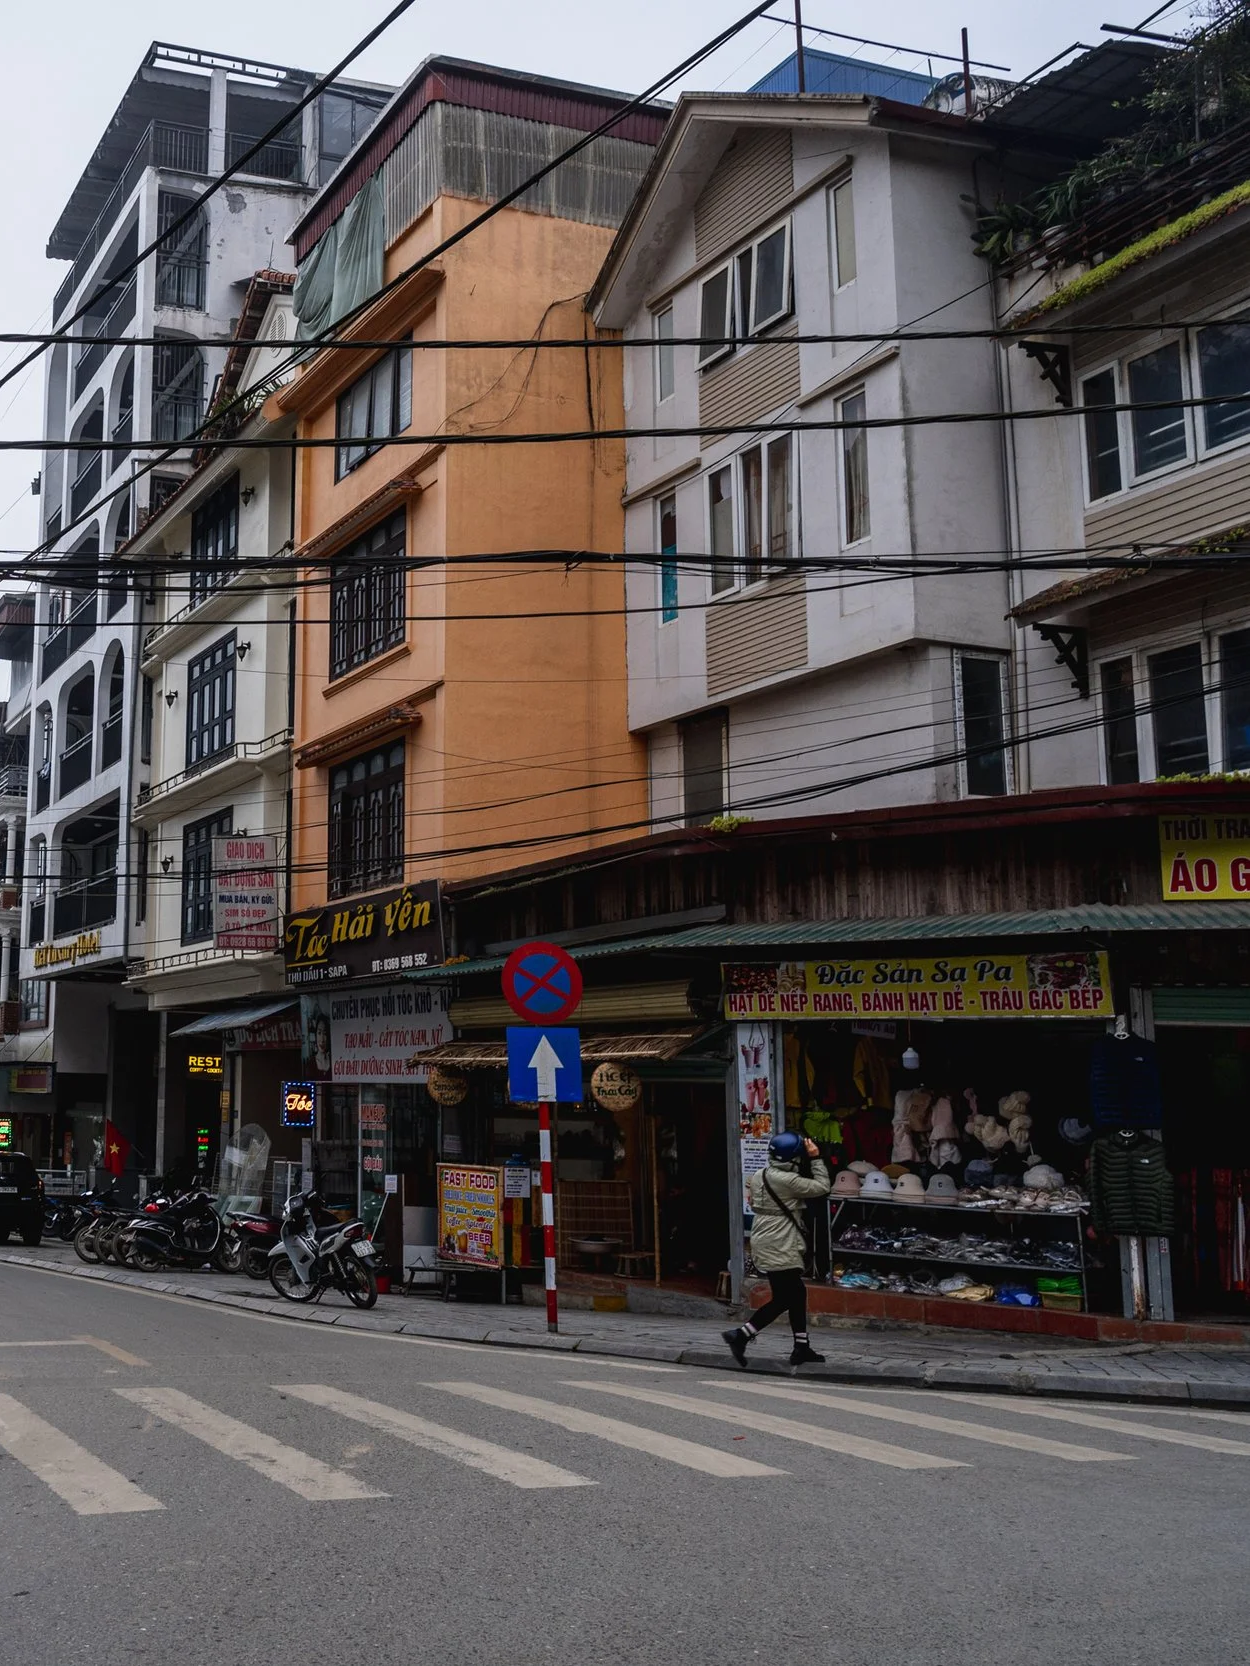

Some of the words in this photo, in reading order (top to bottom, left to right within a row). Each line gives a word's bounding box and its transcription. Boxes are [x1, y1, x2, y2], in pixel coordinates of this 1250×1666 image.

[1162, 817, 1207, 840] THỜI
[1214, 818, 1250, 839] TRA
[226, 841, 244, 859] GIAO
[246, 842, 265, 863] DỊCH
[1170, 852, 1217, 892] ÁO
[218, 895, 233, 904] MUA
[224, 908, 239, 917] SIM
[285, 909, 328, 961] Tóc
[331, 904, 375, 944] Hải
[383, 886, 431, 937] Yến
[414, 953, 427, 967] 552
[328, 965, 348, 978] SAPA
[815, 963, 865, 987] Đặc
[871, 962, 923, 984] Sản
[931, 961, 966, 983] Sa
[973, 959, 1012, 982] Pa
[360, 996, 380, 1022] PHỤC
[397, 989, 413, 1015] TÓC
[414, 987, 432, 1014] KHÔ
[728, 994, 754, 1016] HẠT
[780, 986, 809, 1012] NẾP
[813, 993, 858, 1014] RANG,
[908, 991, 938, 1016] HẠT
[943, 984, 964, 1011] DẺ
[979, 986, 1024, 1011] TRÂU
[1028, 985, 1064, 1010] GÁC
[1069, 982, 1104, 1010] BẾP
[188, 1055, 222, 1067] REST
[285, 1093, 314, 1111] Tóc
[444, 1171, 467, 1186] FAST
[469, 1174, 495, 1190] FOOD
[468, 1232, 491, 1244] BEER
